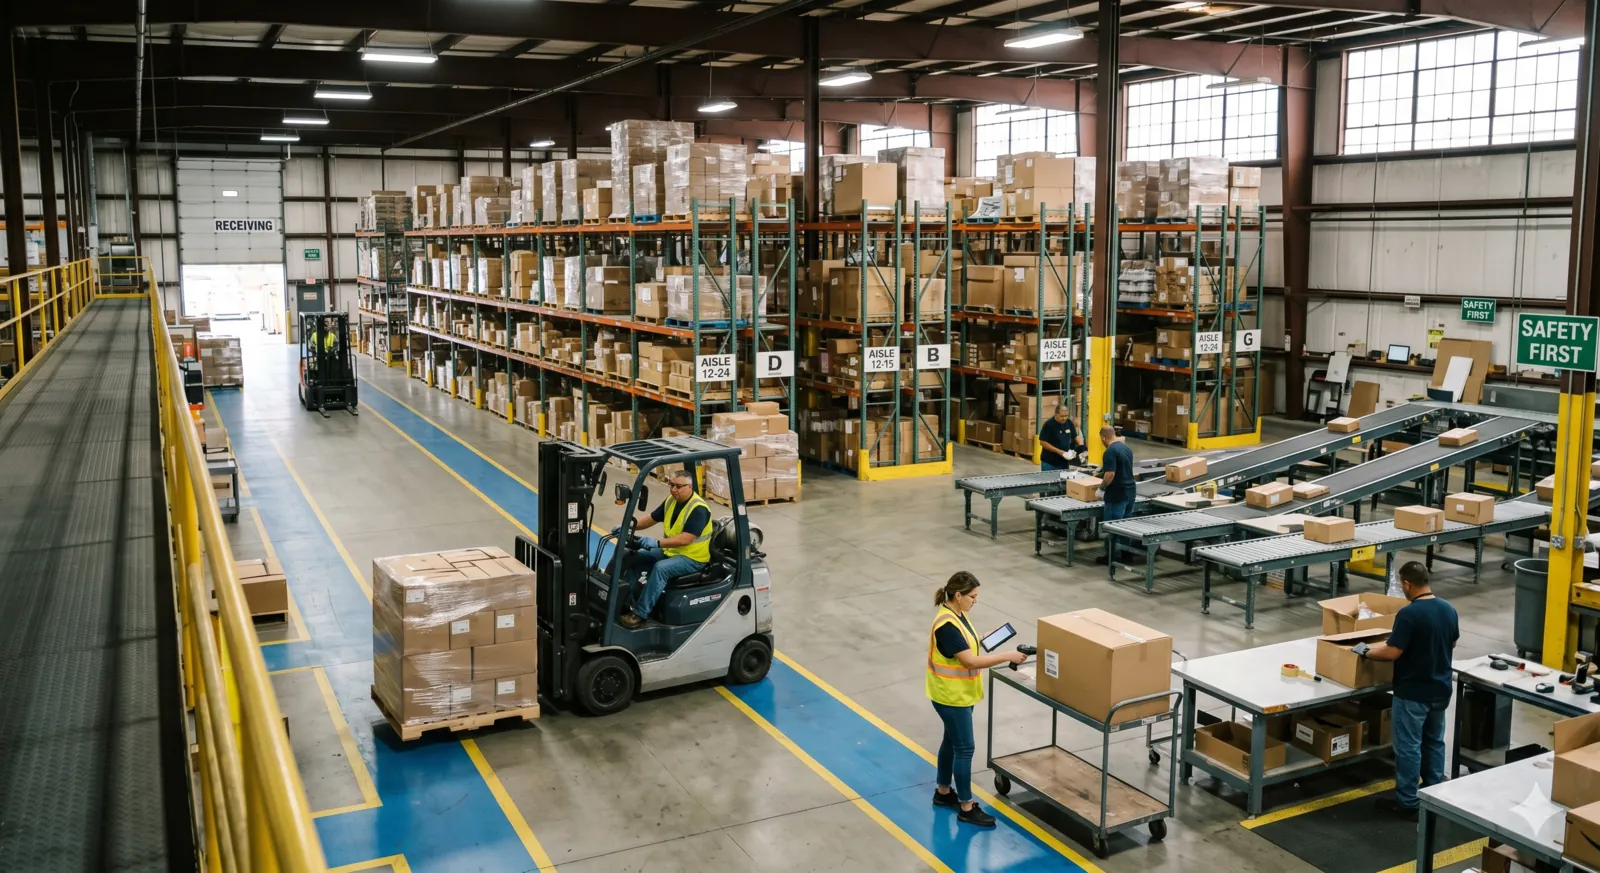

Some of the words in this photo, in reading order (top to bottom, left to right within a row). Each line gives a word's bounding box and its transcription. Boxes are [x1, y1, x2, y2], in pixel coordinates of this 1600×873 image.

[215, 220, 273, 231] RECEIVING
[1463, 300, 1494, 310] SAFETY
[1466, 310, 1490, 320] FIRST
[1521, 319, 1594, 341] SAFETY
[1198, 333, 1219, 342] AISLE
[1243, 332, 1253, 346] G
[1043, 340, 1067, 349] AISLE
[1200, 343, 1218, 352] 12-24
[868, 349, 895, 359] AISLE
[927, 347, 940, 362] B
[1529, 342, 1583, 364] FIRST
[701, 357, 731, 367] AISLE
[768, 355, 782, 371] D
[871, 359, 894, 369] 12-15
[702, 368, 731, 379] 12-24
